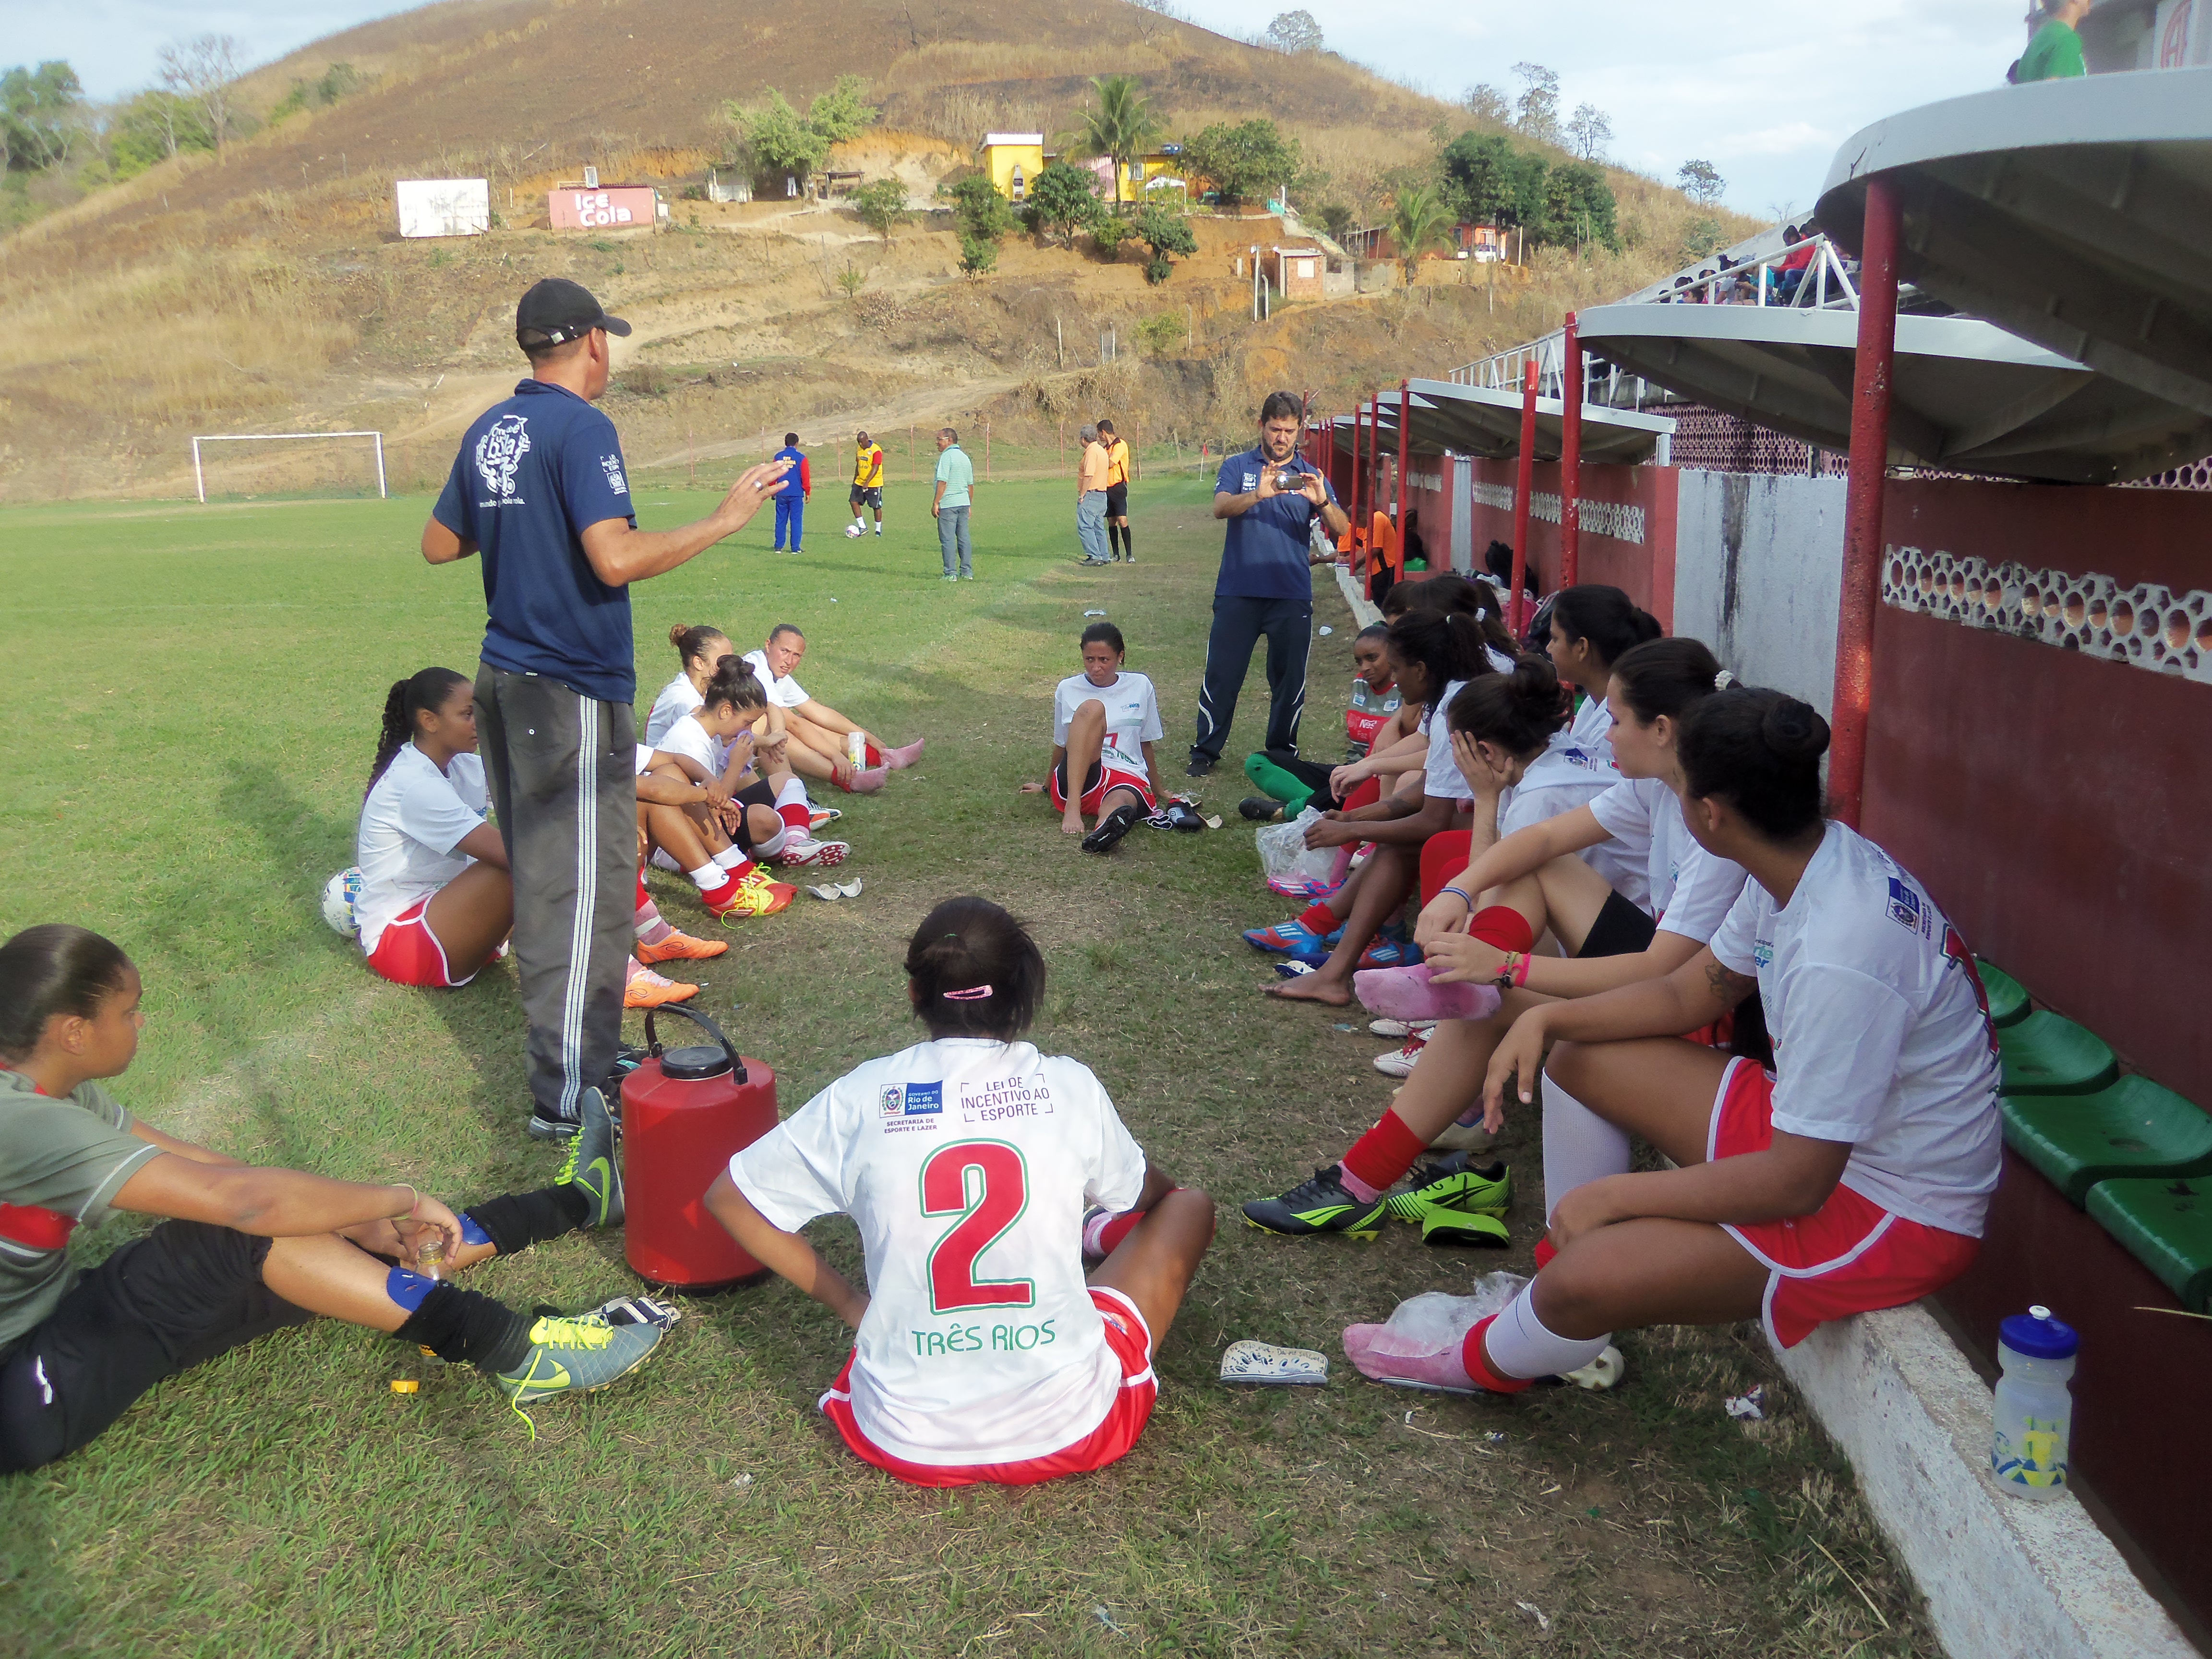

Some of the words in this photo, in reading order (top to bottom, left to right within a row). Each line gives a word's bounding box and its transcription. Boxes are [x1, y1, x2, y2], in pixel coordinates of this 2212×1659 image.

[576, 193, 609, 211] Ice
[580, 206, 632, 227] Cola
[986, 1081, 1004, 1091] LEI
[1008, 1077, 1023, 1088] DE
[907, 1102, 939, 1110] Janeiro
[961, 1090, 1031, 1109] INCENTIVO
[1034, 1088, 1050, 1100] AO
[981, 1103, 1038, 1121] ESPORTE
[918, 1138, 1036, 1316] 2
[912, 1323, 983, 1356] TRÊS
[992, 1319, 1056, 1351] RIOS
